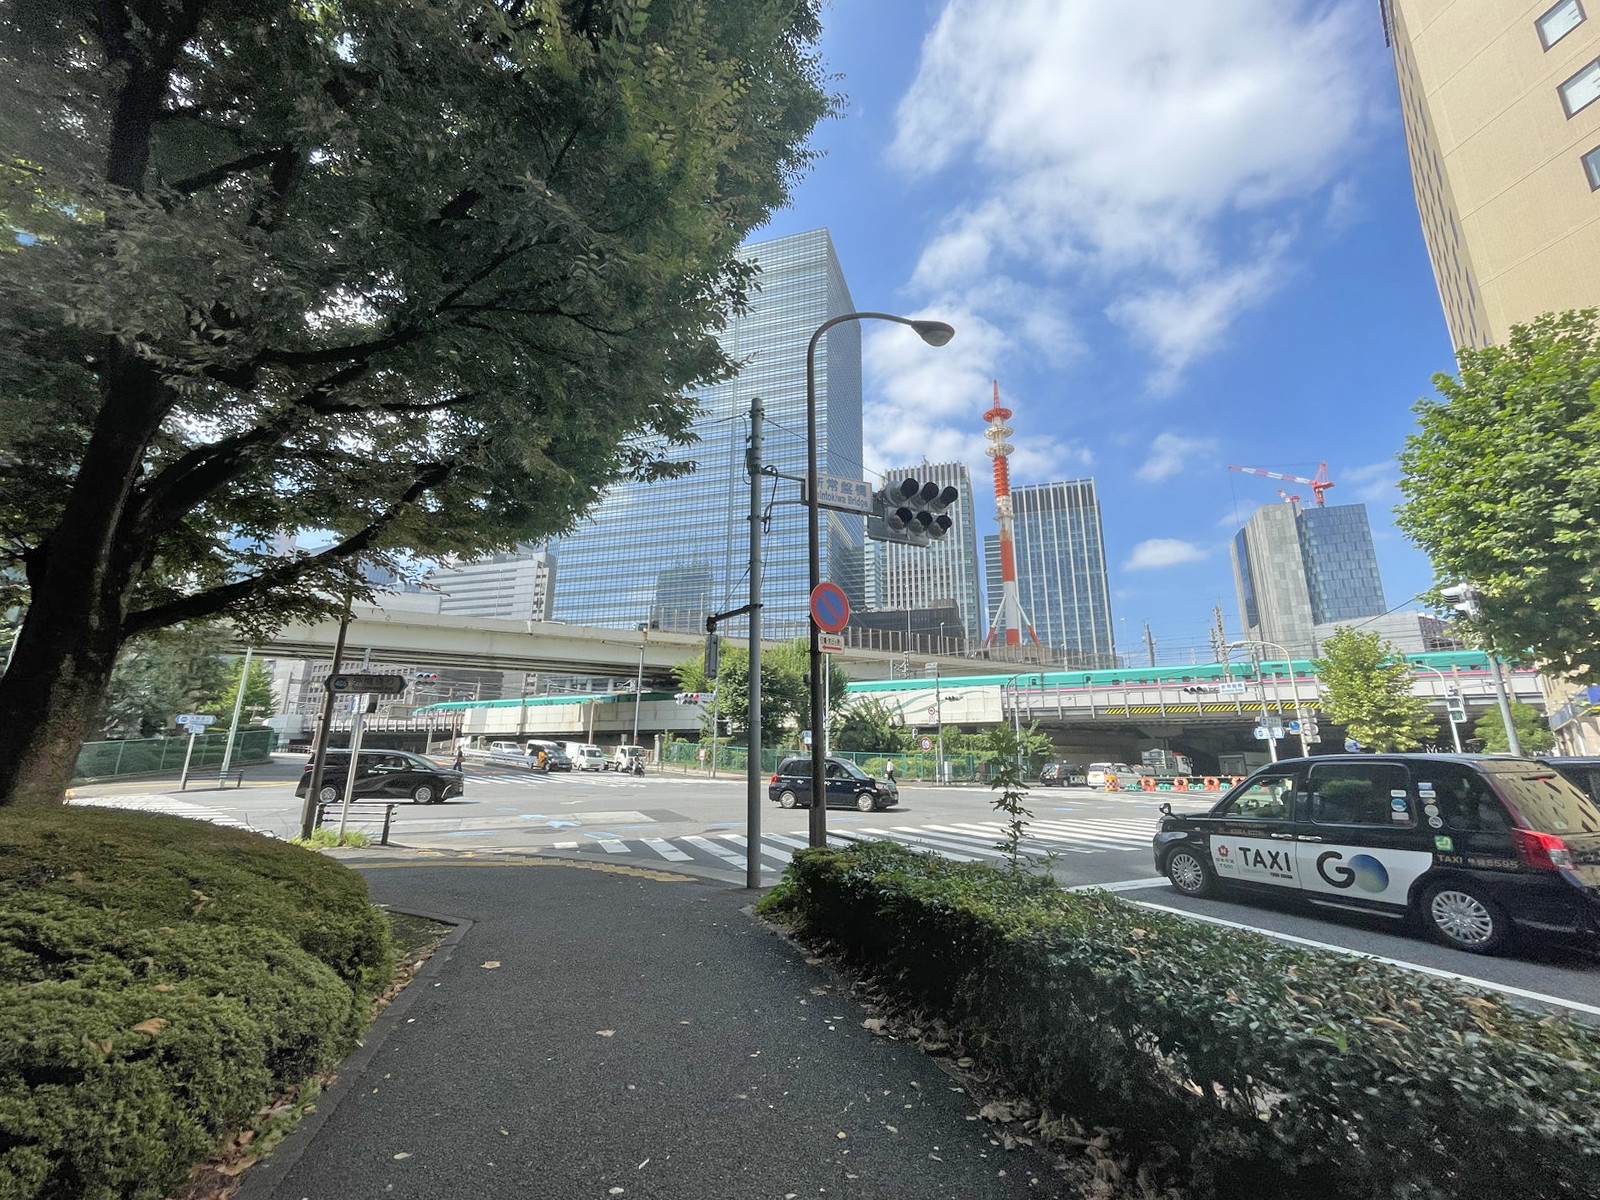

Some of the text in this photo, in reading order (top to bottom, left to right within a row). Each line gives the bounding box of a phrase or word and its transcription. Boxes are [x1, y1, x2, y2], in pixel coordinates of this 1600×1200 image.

[817, 490, 868, 509] intokiwa Bridge
[1238, 846, 1292, 872] TAXI
[1437, 854, 1463, 864] TAXI
